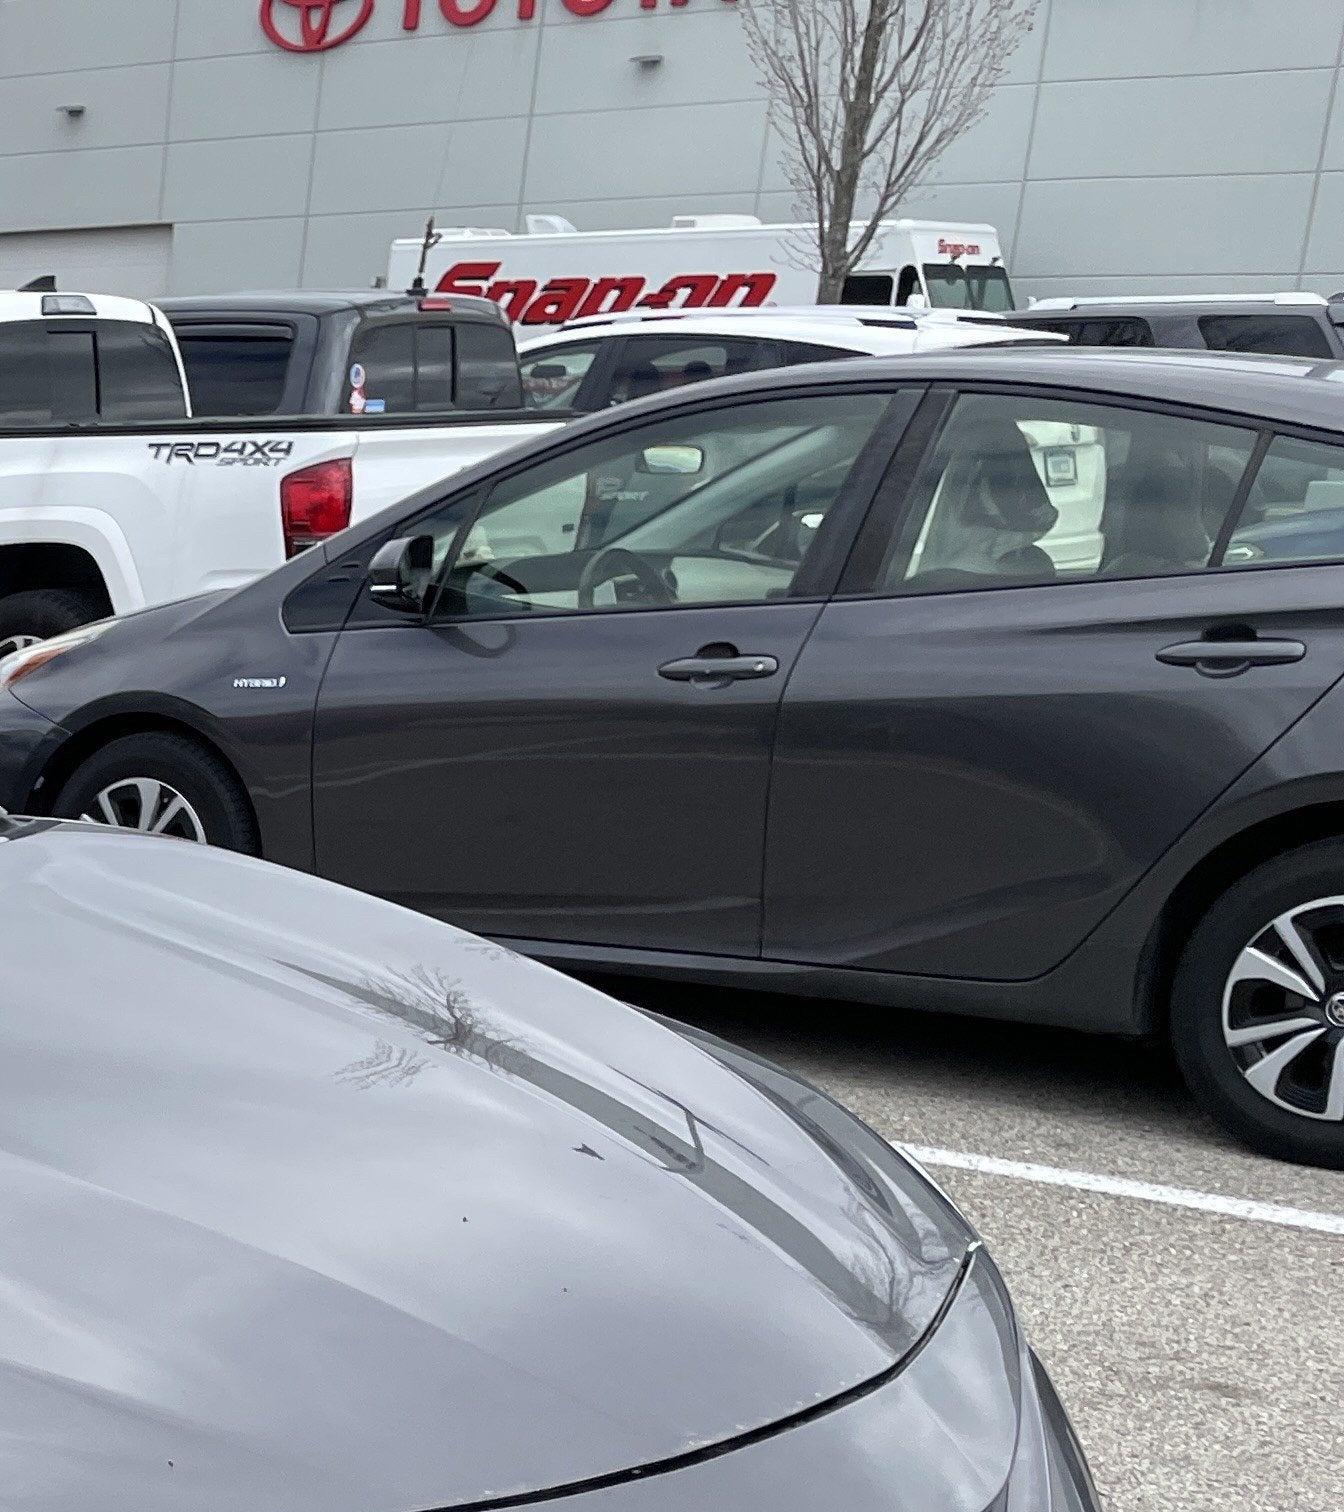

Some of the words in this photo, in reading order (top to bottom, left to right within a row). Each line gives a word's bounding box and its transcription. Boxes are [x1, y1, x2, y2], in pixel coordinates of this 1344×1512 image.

[435, 261, 777, 326] Snap-on
[148, 442, 221, 465] TRD
[222, 441, 294, 456] 4X4
[216, 457, 286, 466] SPORT
